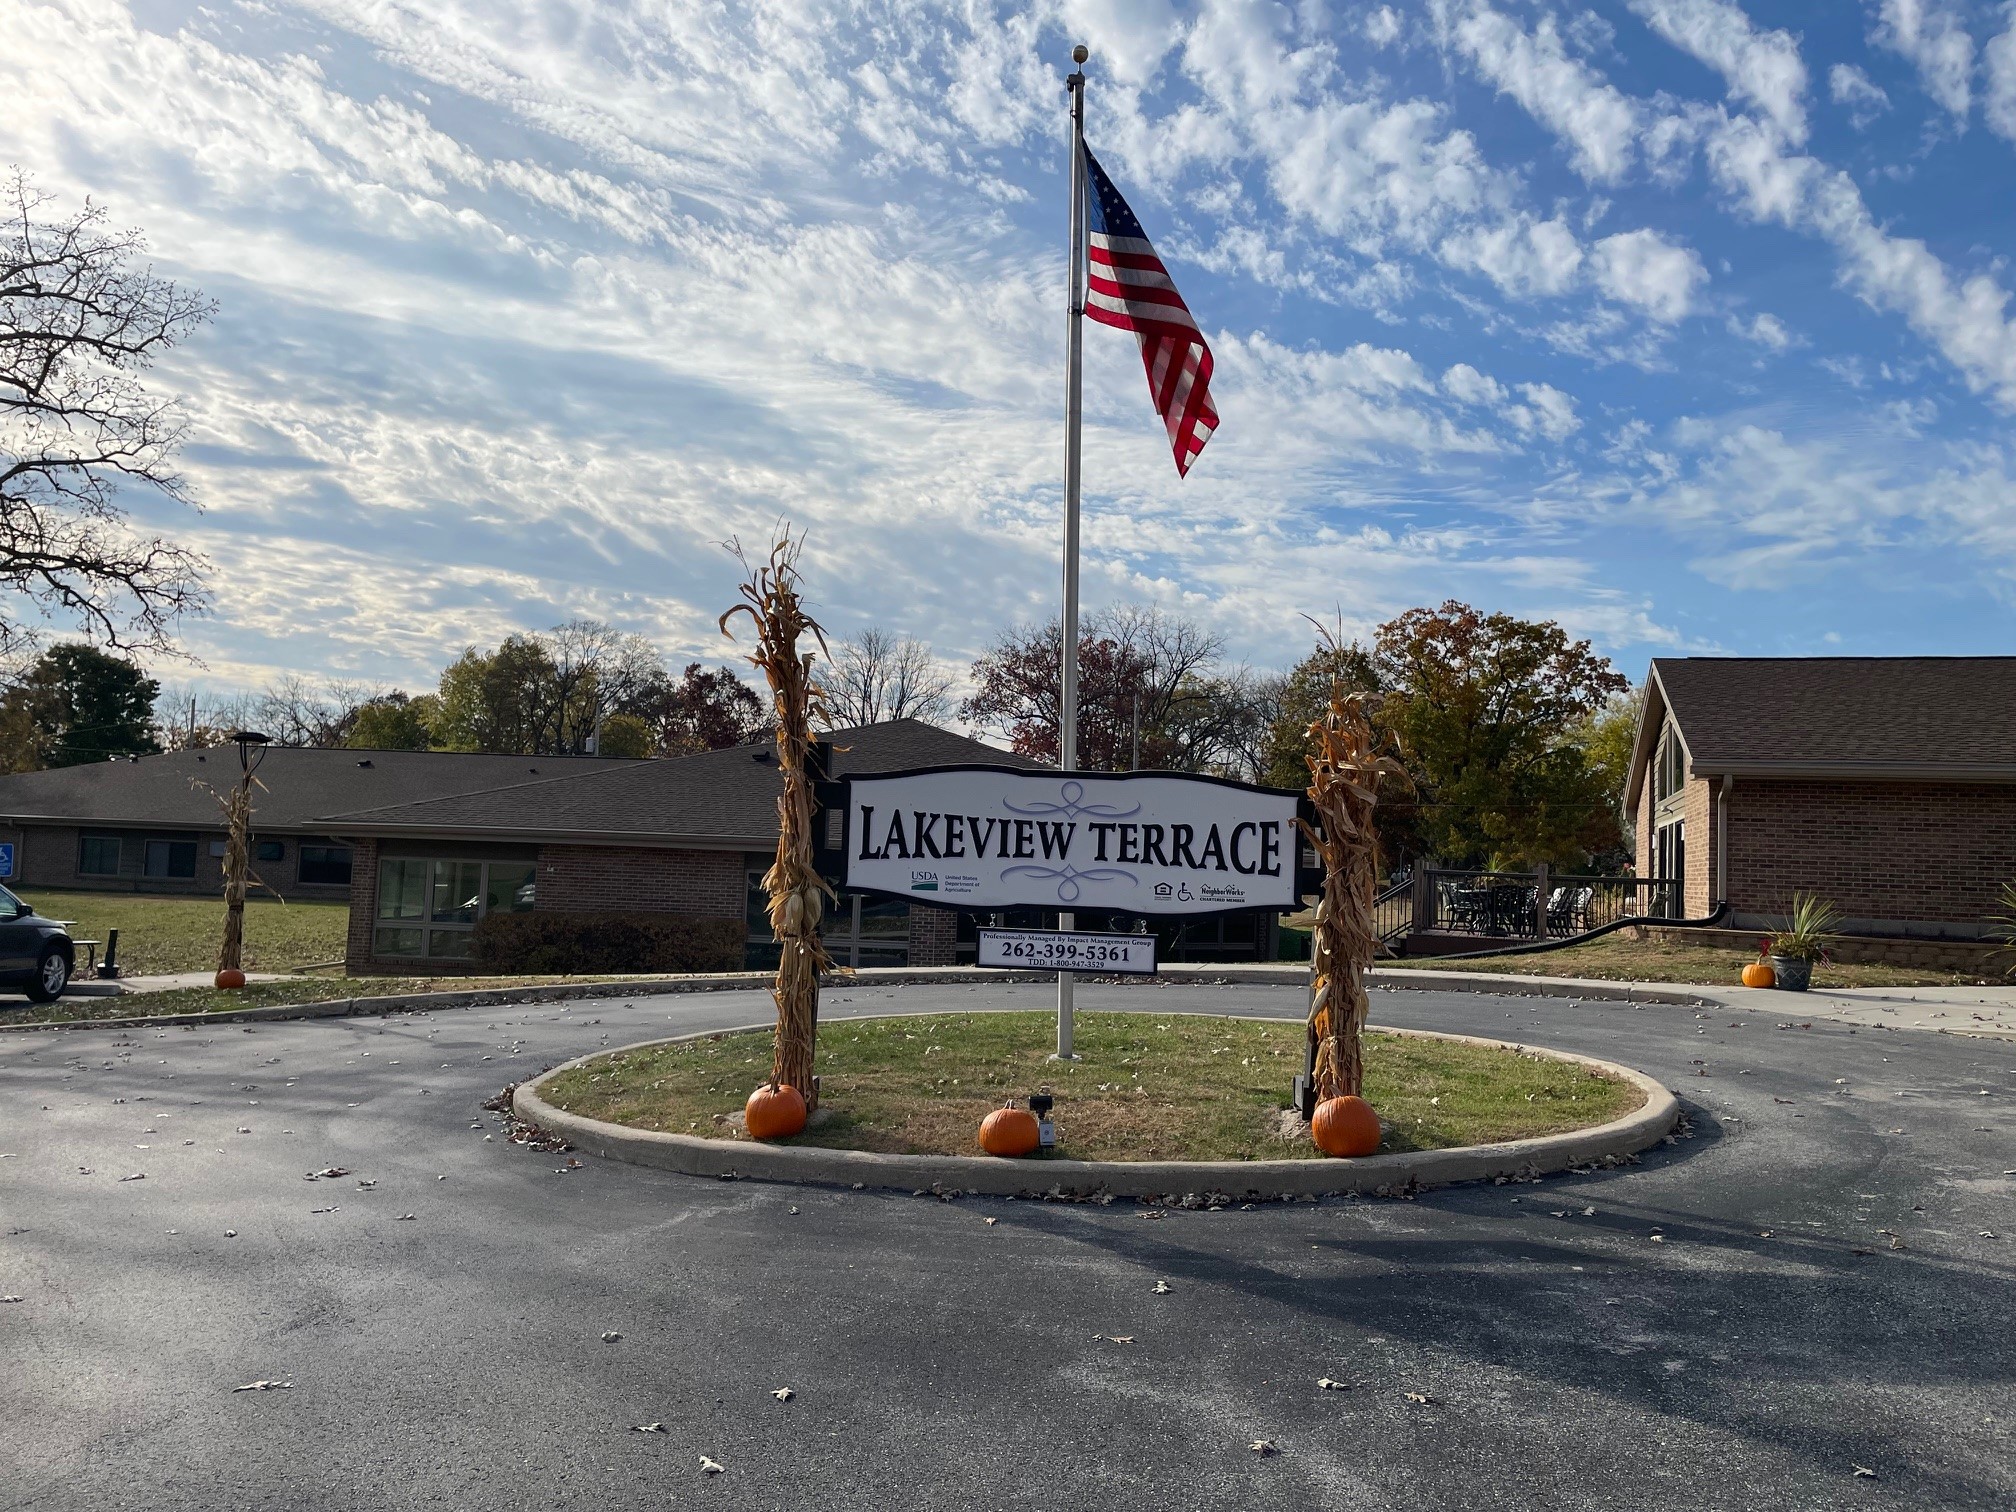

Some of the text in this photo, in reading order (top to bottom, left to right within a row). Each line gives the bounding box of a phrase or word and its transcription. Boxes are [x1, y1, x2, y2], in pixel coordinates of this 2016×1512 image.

[859, 804, 1281, 877] LAKEVIEW TERRACE
[911, 871, 939, 880] USDA
[983, 933, 1026, 942] Professionally
[1028, 935, 1056, 943] Managed
[1067, 936, 1089, 944] Impact
[1090, 937, 1130, 945] Management
[1131, 939, 1152, 947] Group
[1001, 942, 1130, 962] 262-399-5361
[1028, 958, 1105, 968] TDD: 1-800-947-3529
